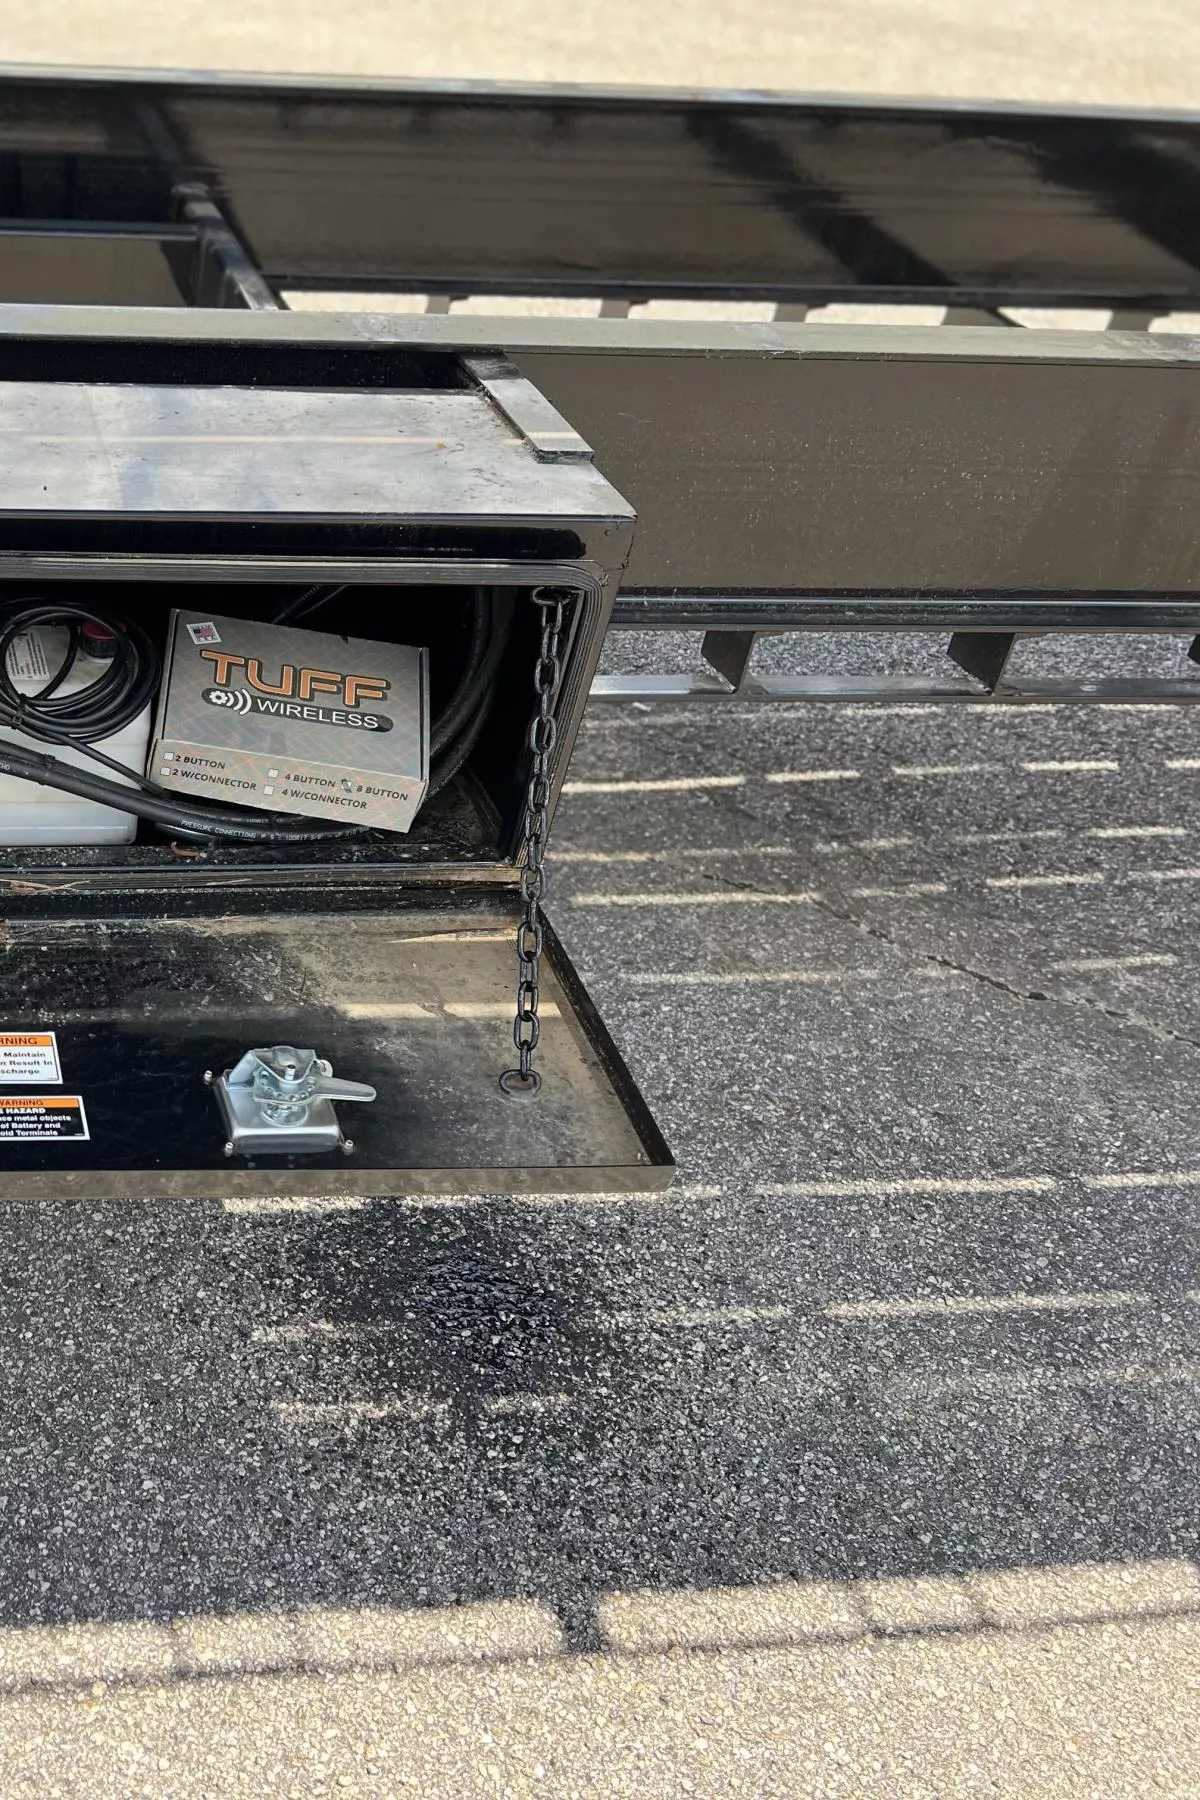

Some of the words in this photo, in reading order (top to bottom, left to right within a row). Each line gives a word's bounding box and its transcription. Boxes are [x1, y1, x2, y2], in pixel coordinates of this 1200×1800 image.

[201, 650, 390, 707] TUFF
[257, 698, 379, 729] WIRELESS
[174, 754, 182, 762] 2
[184, 755, 226, 770] BUTTON
[172, 768, 179, 776] 2
[180, 769, 257, 791] W/CONNECTOR
[285, 773, 292, 781] 4
[294, 774, 336, 788] BUTTON
[281, 788, 288, 796] 4
[290, 789, 368, 809] W/CONNECTOR
[364, 786, 409, 801] BUTTON
[214, 827, 257, 840] CONNECTIONS
[40, 1115, 71, 1123] objects
[11, 1123, 42, 1131] Battery
